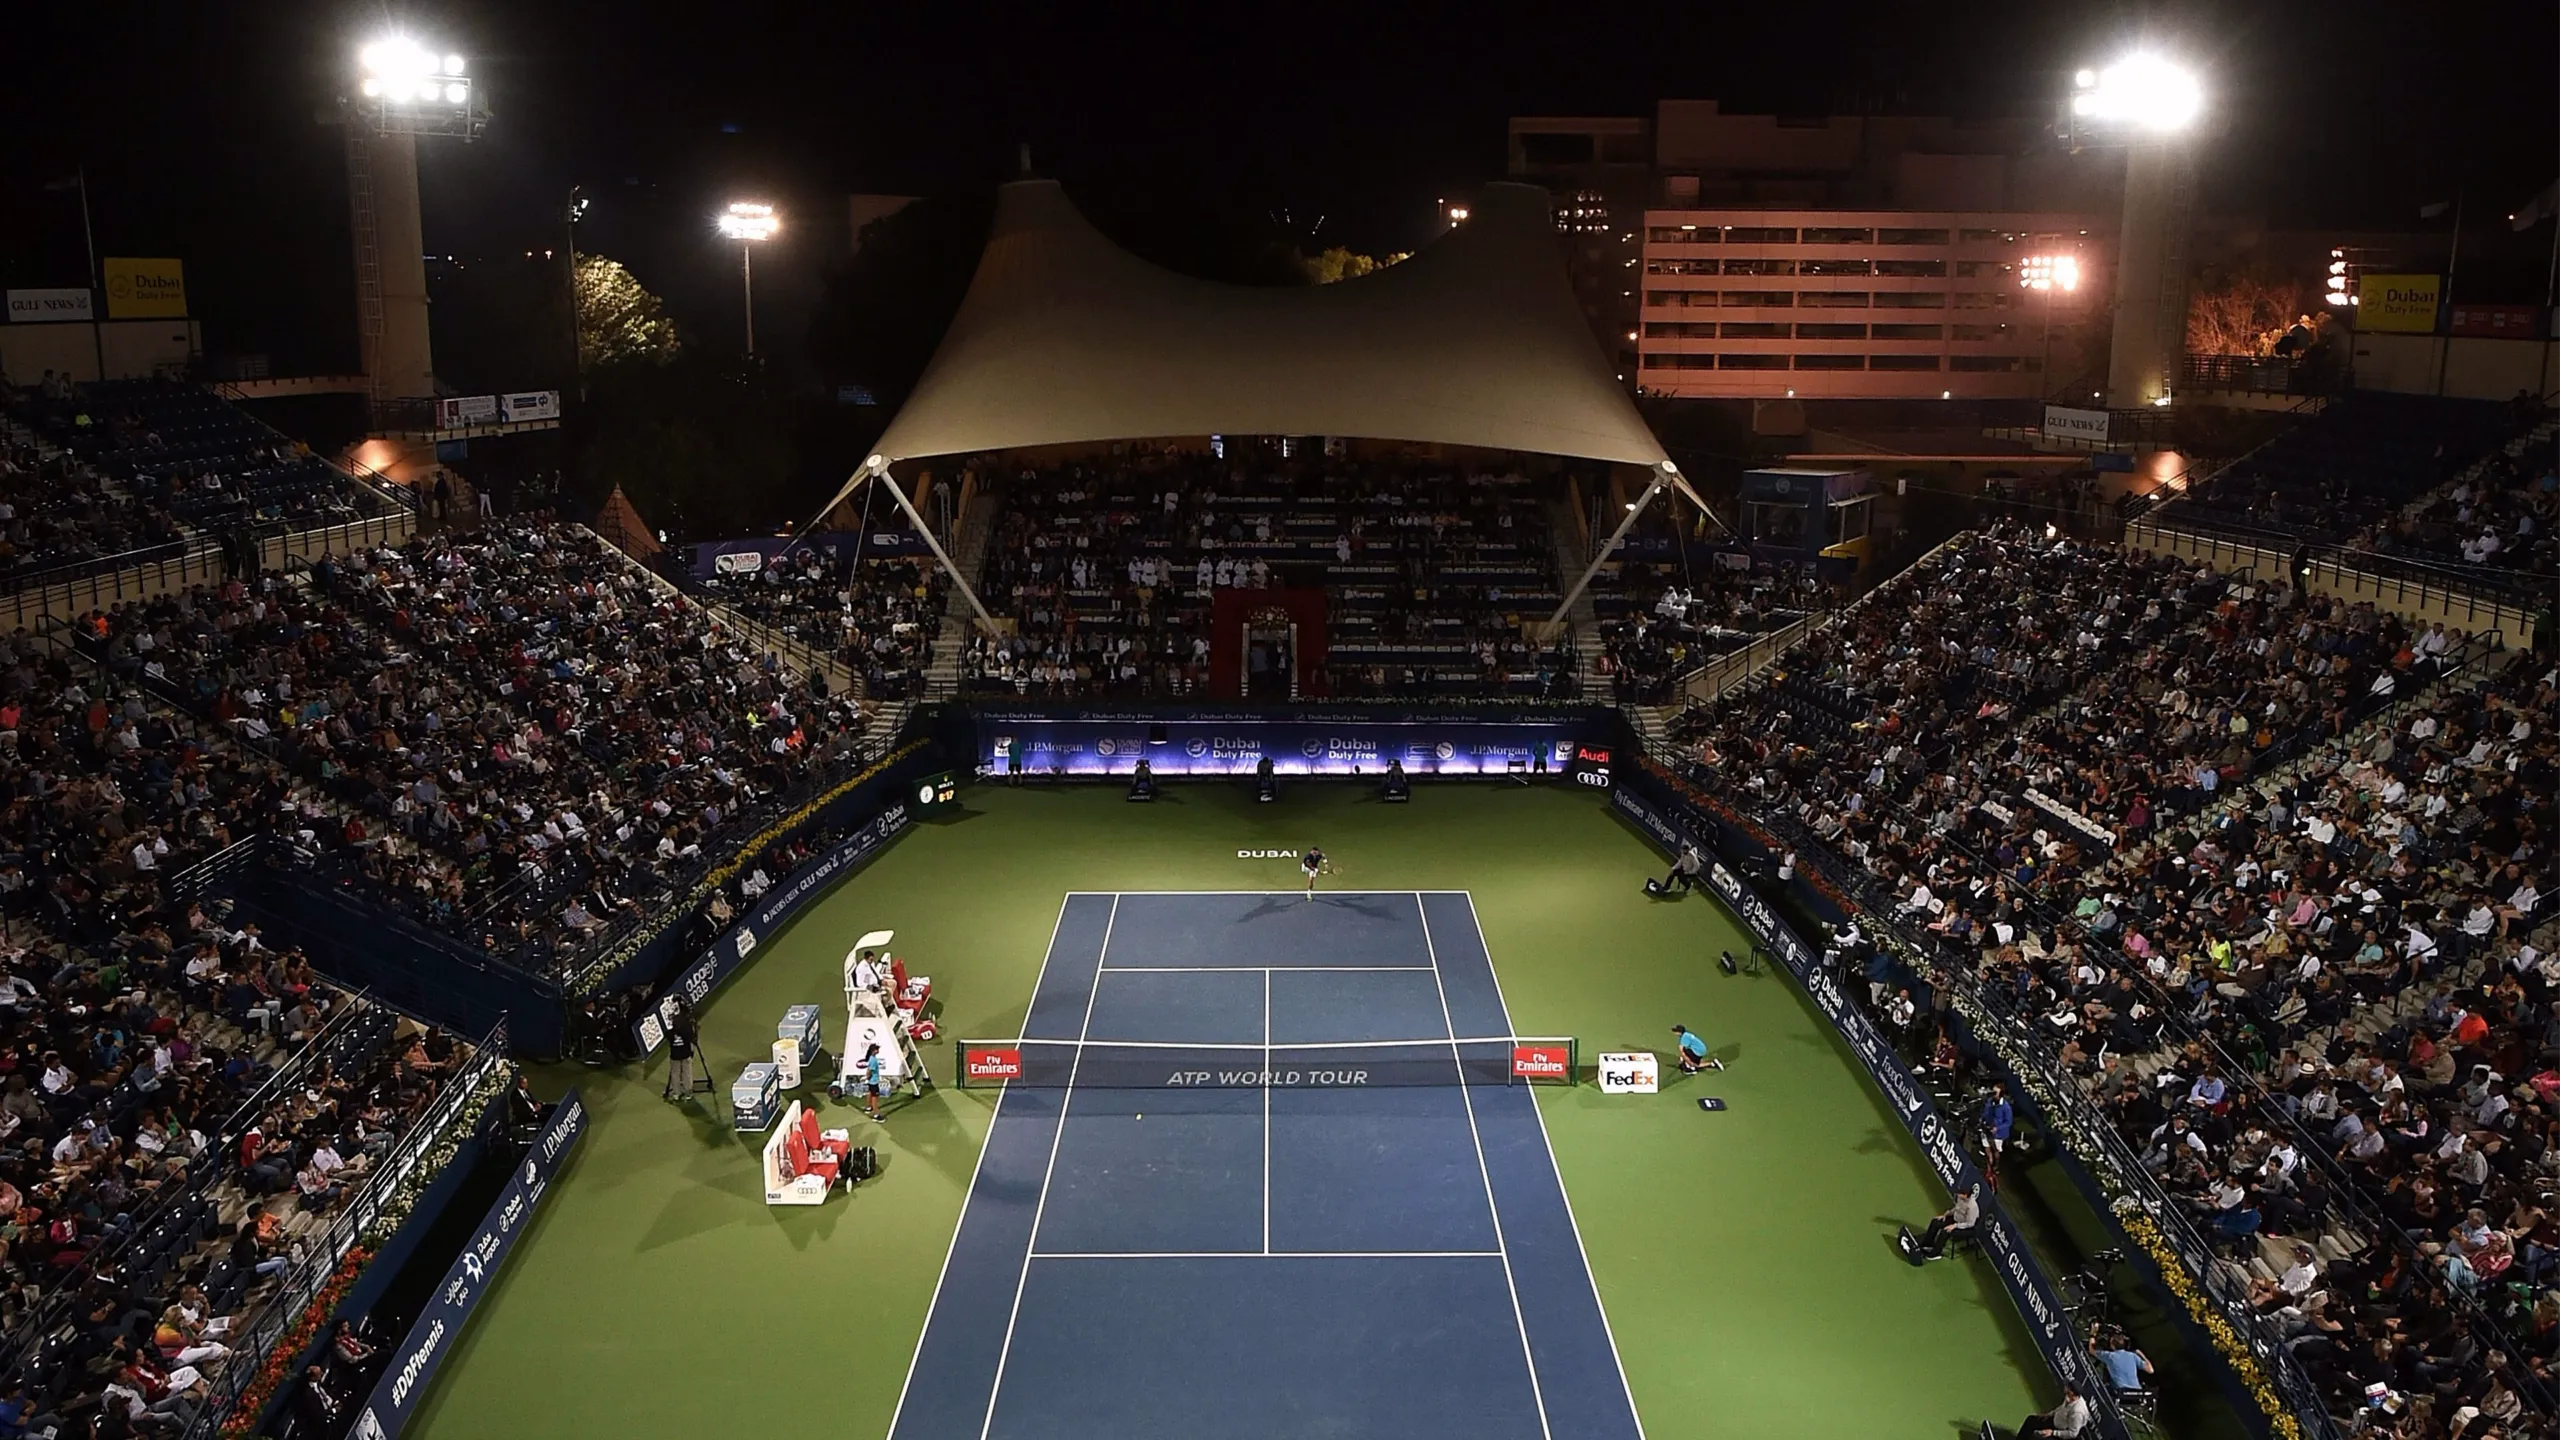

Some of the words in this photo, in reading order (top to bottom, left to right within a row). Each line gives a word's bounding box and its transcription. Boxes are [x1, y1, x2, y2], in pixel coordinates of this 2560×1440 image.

[136, 275, 180, 289] Dubai
[2387, 289, 2434, 303] Dubai
[12, 300, 40, 311] GULF
[44, 299, 74, 310] NEWS
[1025, 741, 1083, 755] J.P.Morgan
[1213, 737, 1260, 749] Dubai
[1329, 738, 1376, 750] Dubai
[1213, 750, 1237, 760] Duty
[1239, 750, 1262, 759] Free
[1329, 751, 1353, 761] Duty
[1355, 751, 1378, 760] Free
[1470, 745, 1529, 758] J.P.Morgan
[1578, 748, 1610, 763] Audi
[885, 804, 905, 822] Dubai
[1237, 850, 1298, 858] DUBAI
[800, 873, 816, 890] GULF
[815, 862, 833, 880] NEWS
[1755, 901, 1775, 930] Dubai
[1822, 976, 1843, 1010] Dubai
[1817, 991, 1828, 1011] Duty
[986, 1056, 1001, 1065] Fly
[1533, 1053, 1548, 1062] Fly
[971, 1063, 1018, 1074] Emirates
[1516, 1060, 1563, 1072] Emirates
[1167, 1071, 1211, 1085] ATP
[1218, 1071, 1300, 1085] WORLD
[1308, 1071, 1368, 1085] TOUR
[1607, 1071, 1652, 1085] FedEx
[543, 1101, 583, 1164] J.P.Morgan
[1936, 1127, 1963, 1174] Dubai
[1930, 1146, 1944, 1171] Duty
[1941, 1164, 1955, 1187] Free
[504, 1194, 521, 1217] Dubai
[477, 1230, 492, 1254] Dubai
[1994, 1221, 2010, 1250] Dubai
[482, 1236, 500, 1265] Airports
[2008, 1252, 2029, 1288] GULF
[2024, 1282, 2049, 1324] NEWS
[392, 1319, 444, 1408] #DDFtennis
[2064, 1346, 2076, 1374] Win
